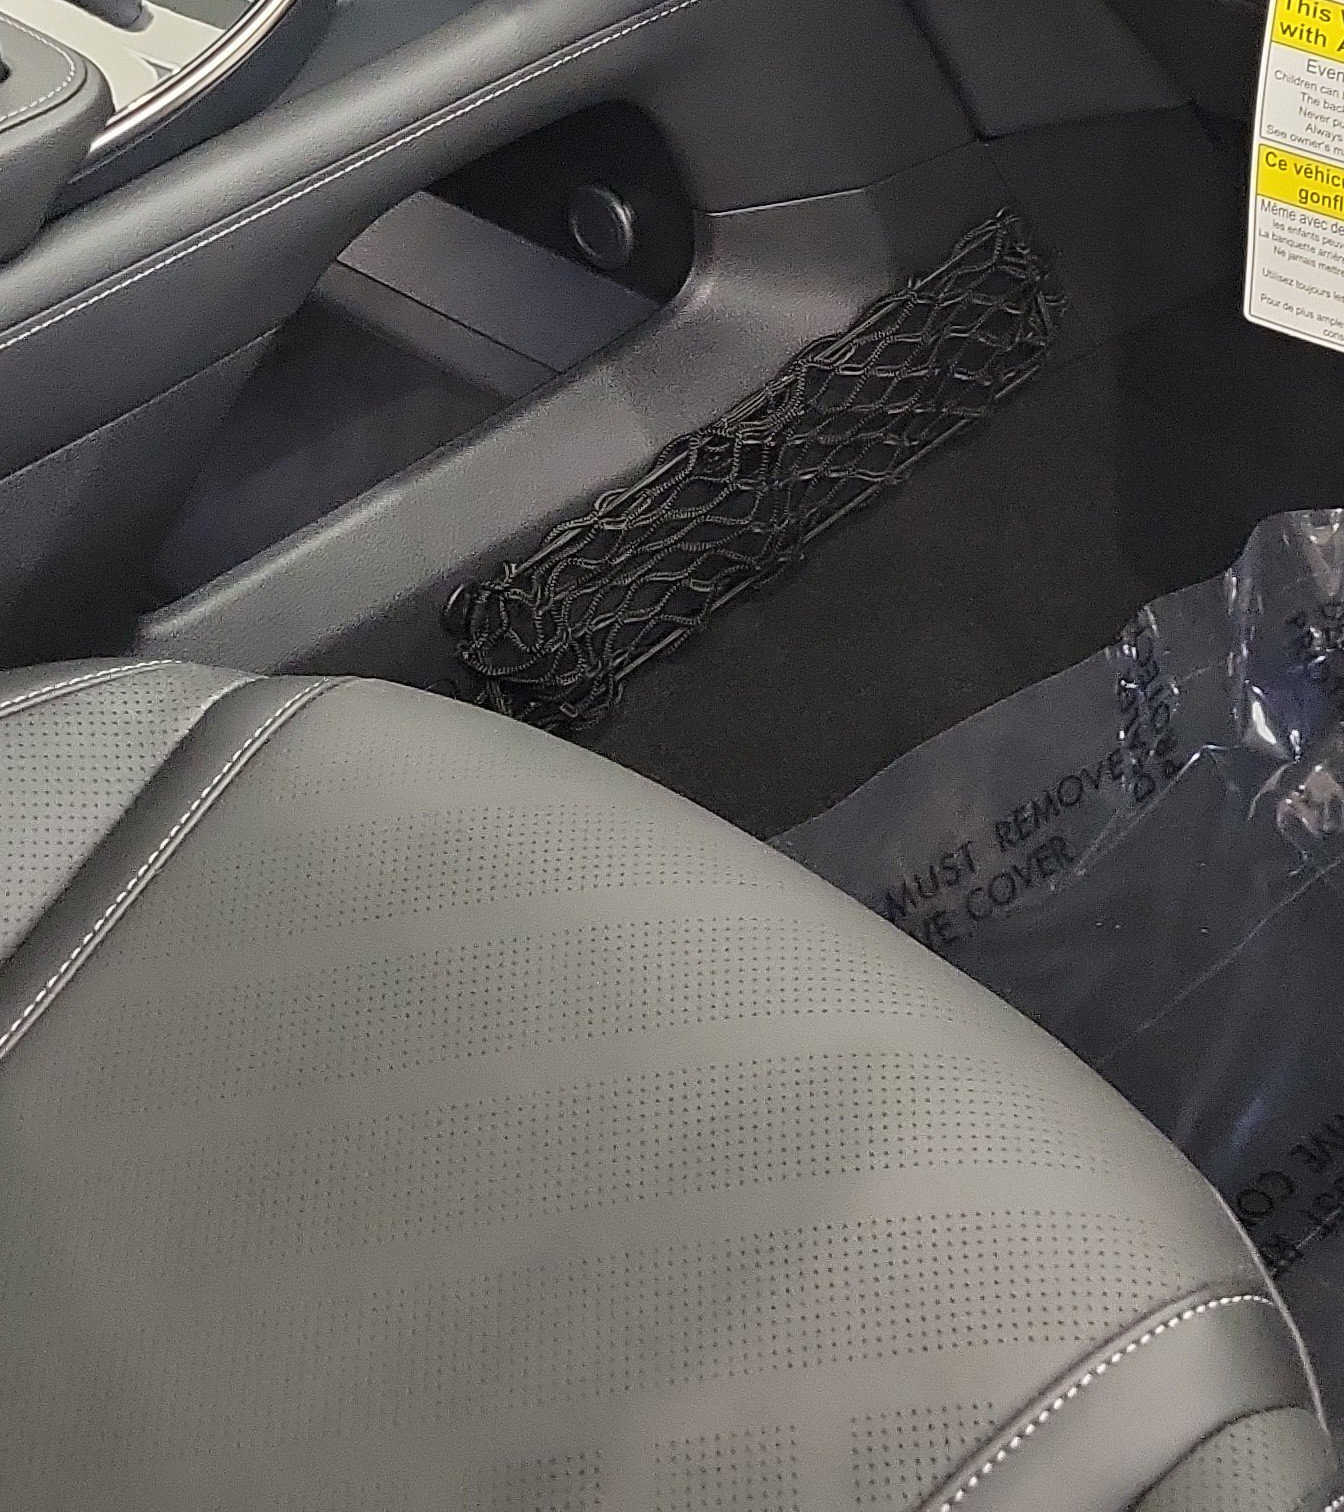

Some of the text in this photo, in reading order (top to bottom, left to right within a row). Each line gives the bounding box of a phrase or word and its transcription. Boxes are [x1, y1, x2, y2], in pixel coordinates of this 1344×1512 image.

[1279, 21, 1326, 47] with
[1273, 69, 1317, 91] Children
[1318, 85, 1339, 98] can
[1299, 90, 1320, 106] The
[1298, 105, 1331, 123] Never
[1266, 123, 1287, 139] See
[1288, 133, 1331, 152] owner's
[1304, 122, 1343, 142] Always
[1264, 150, 1287, 171] Ce
[1298, 213, 1328, 231] avec
[994, 748, 1125, 853] REMOVE
[966, 836, 1076, 921] COVER
